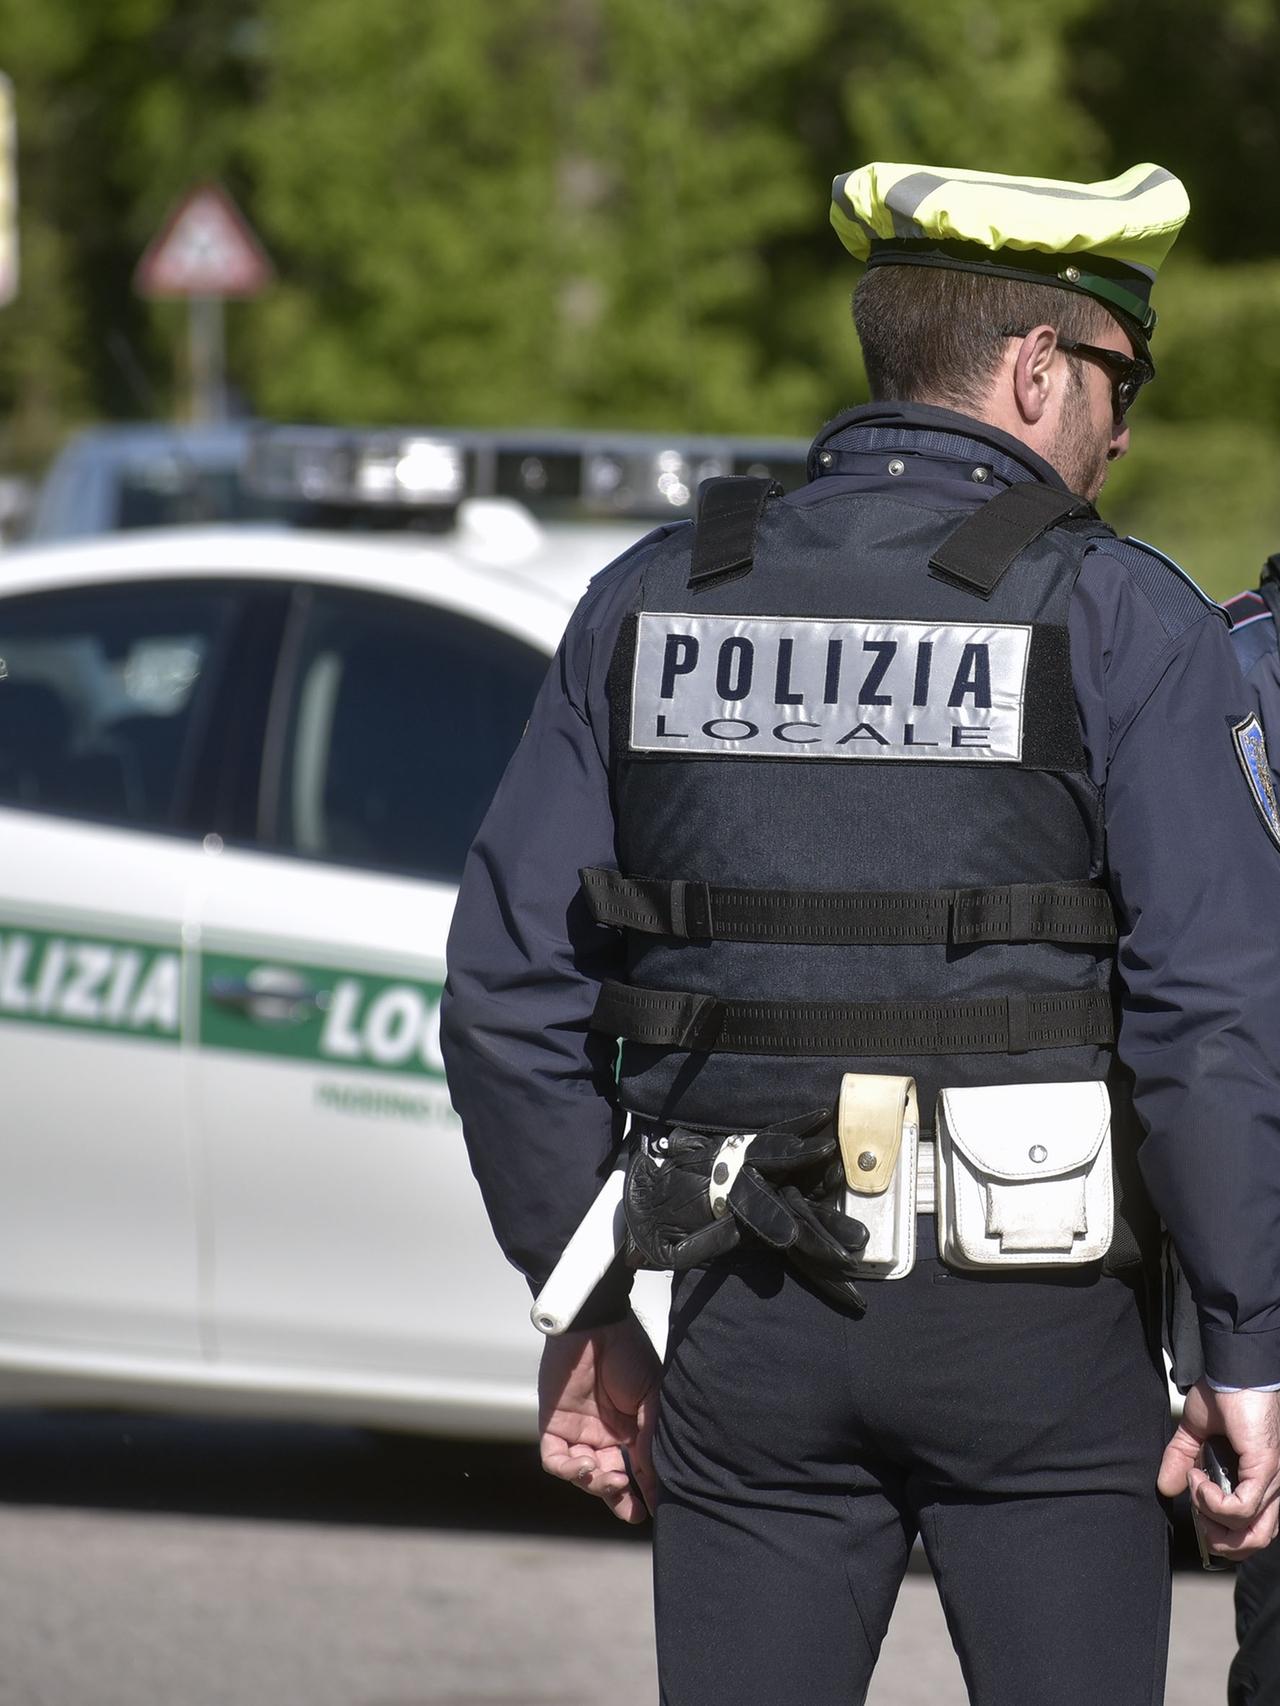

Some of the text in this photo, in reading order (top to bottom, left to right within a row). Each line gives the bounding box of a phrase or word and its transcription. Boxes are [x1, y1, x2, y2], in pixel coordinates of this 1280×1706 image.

[660, 634, 993, 708] POLIZIA
[656, 715, 992, 748] LOCALE
[0, 933, 180, 1030] LIZIA
